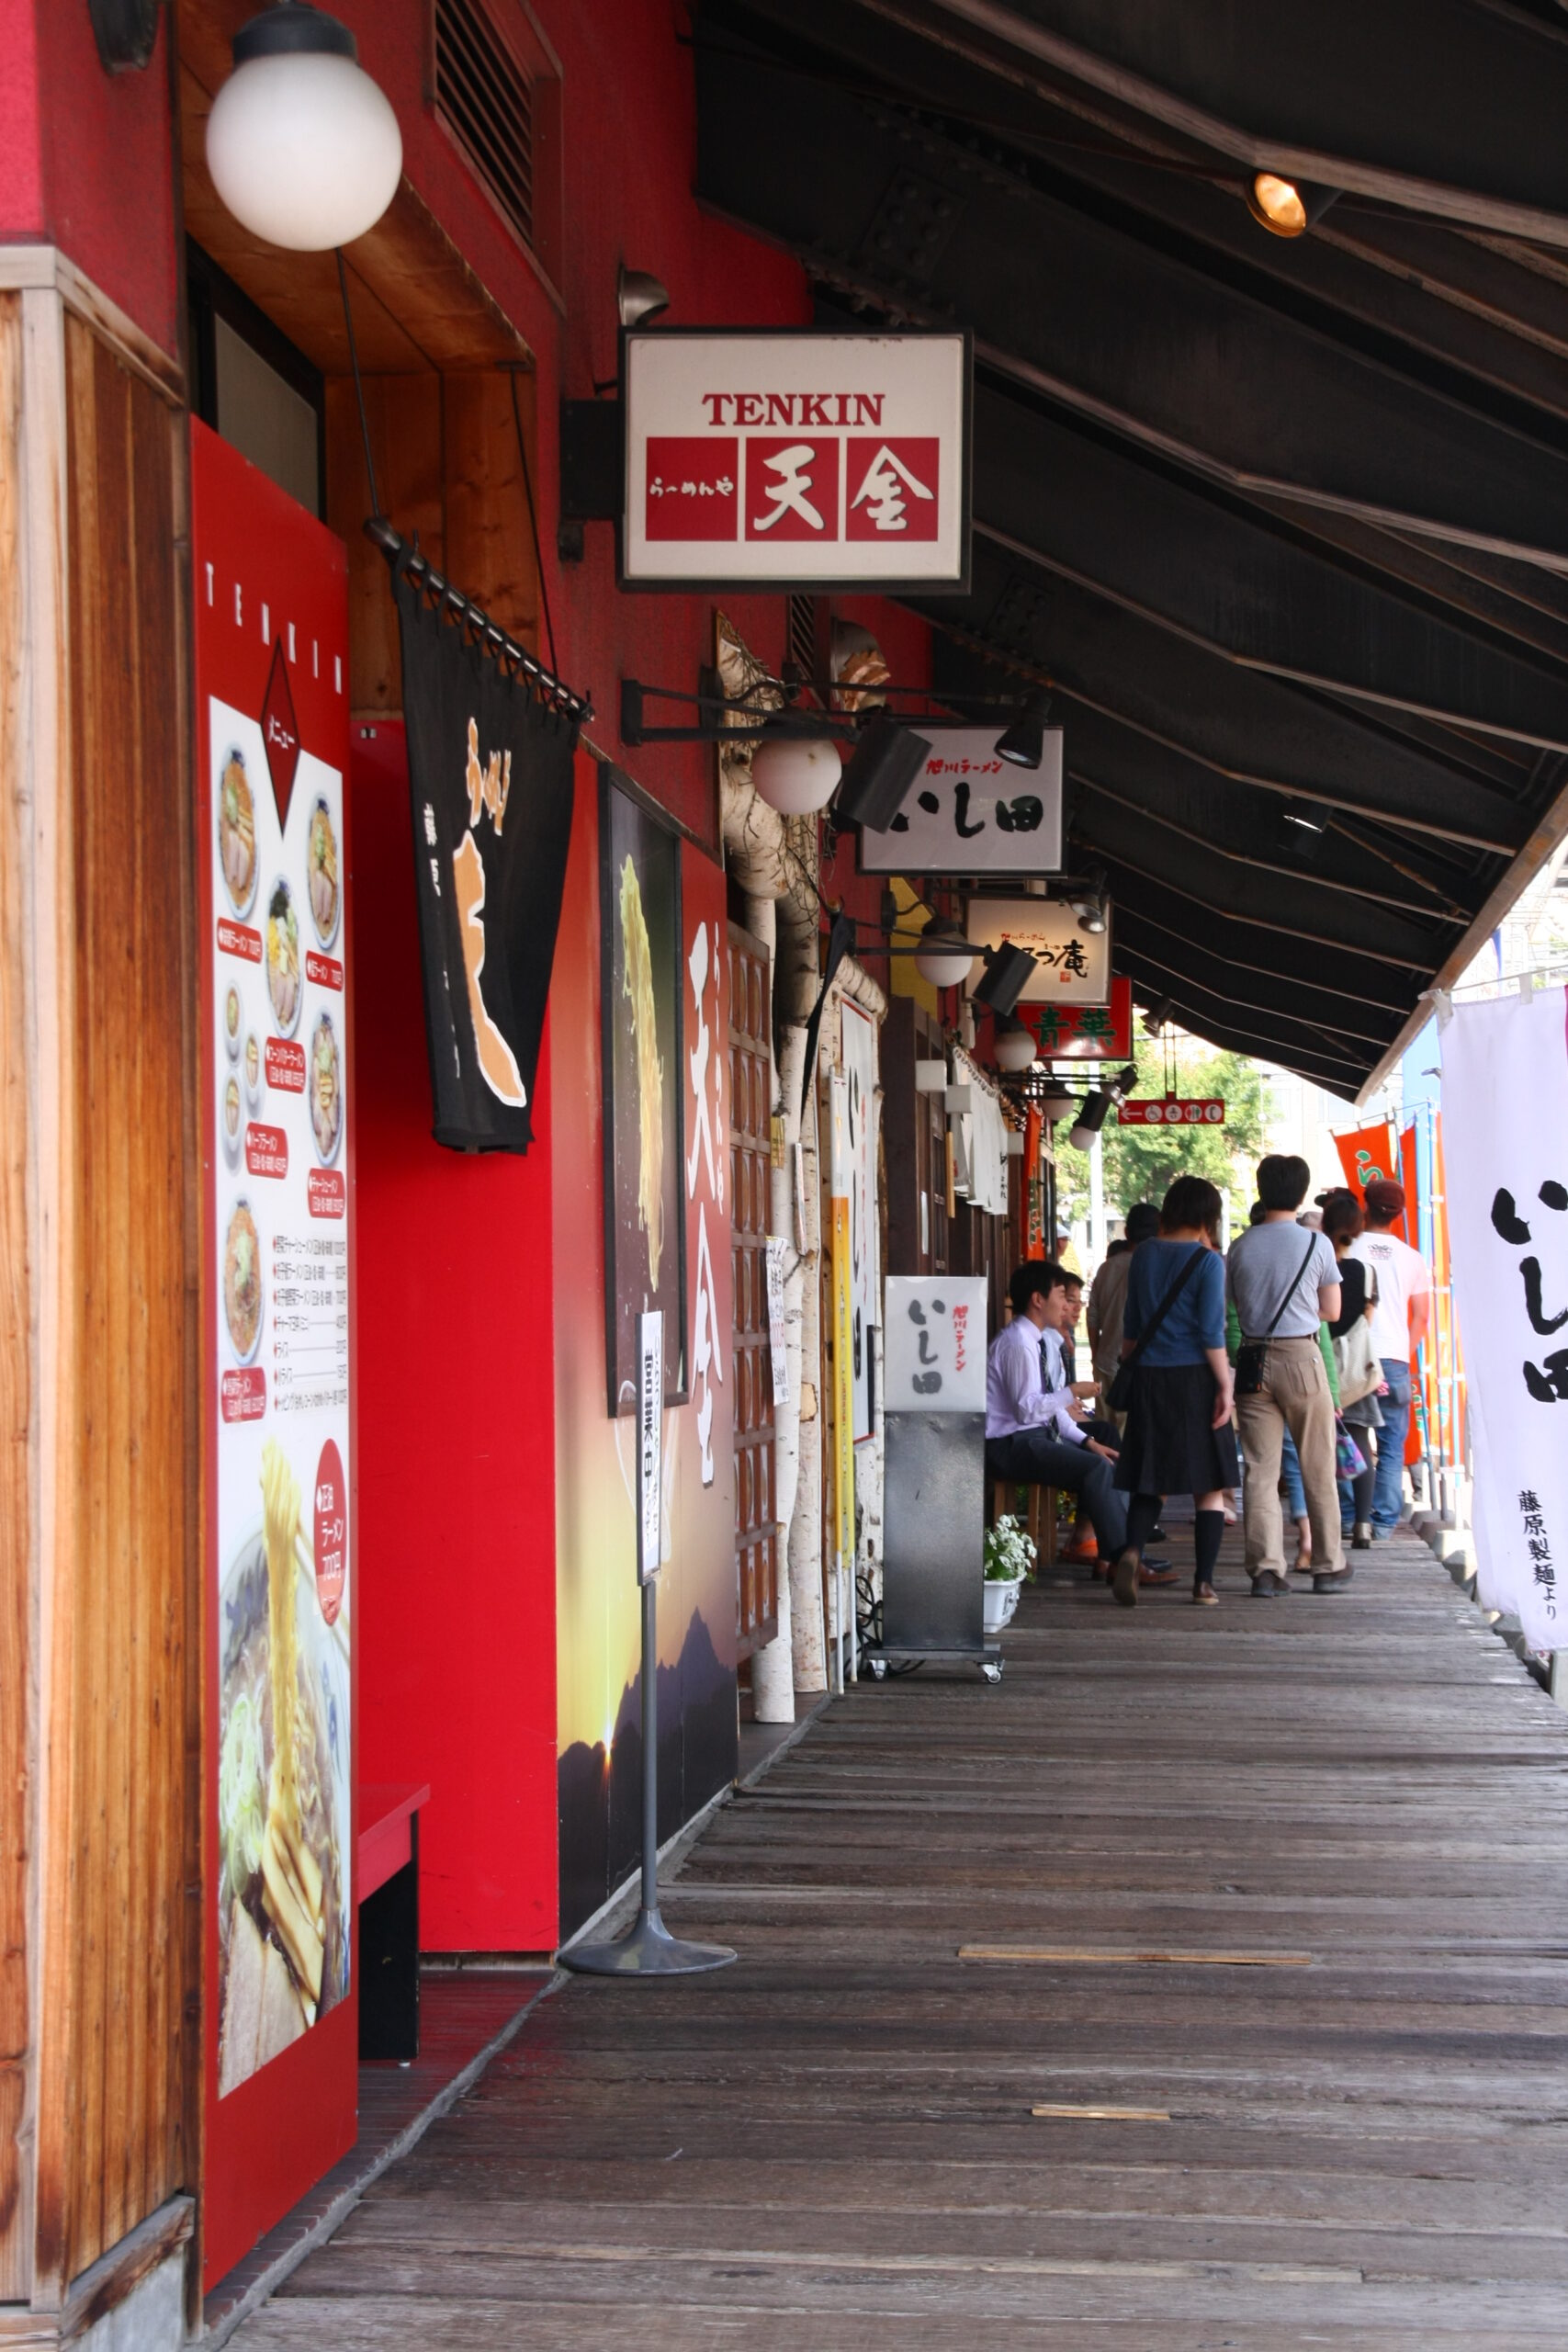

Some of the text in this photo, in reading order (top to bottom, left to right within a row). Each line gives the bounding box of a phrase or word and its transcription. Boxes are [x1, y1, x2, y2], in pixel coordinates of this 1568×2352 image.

[702, 393, 886, 426] TENKIN
[1032, 1006, 1116, 1049] 青葉
[908, 1299, 946, 1395] いし田
[1517, 1489, 1558, 1622] 藤原製麺より
